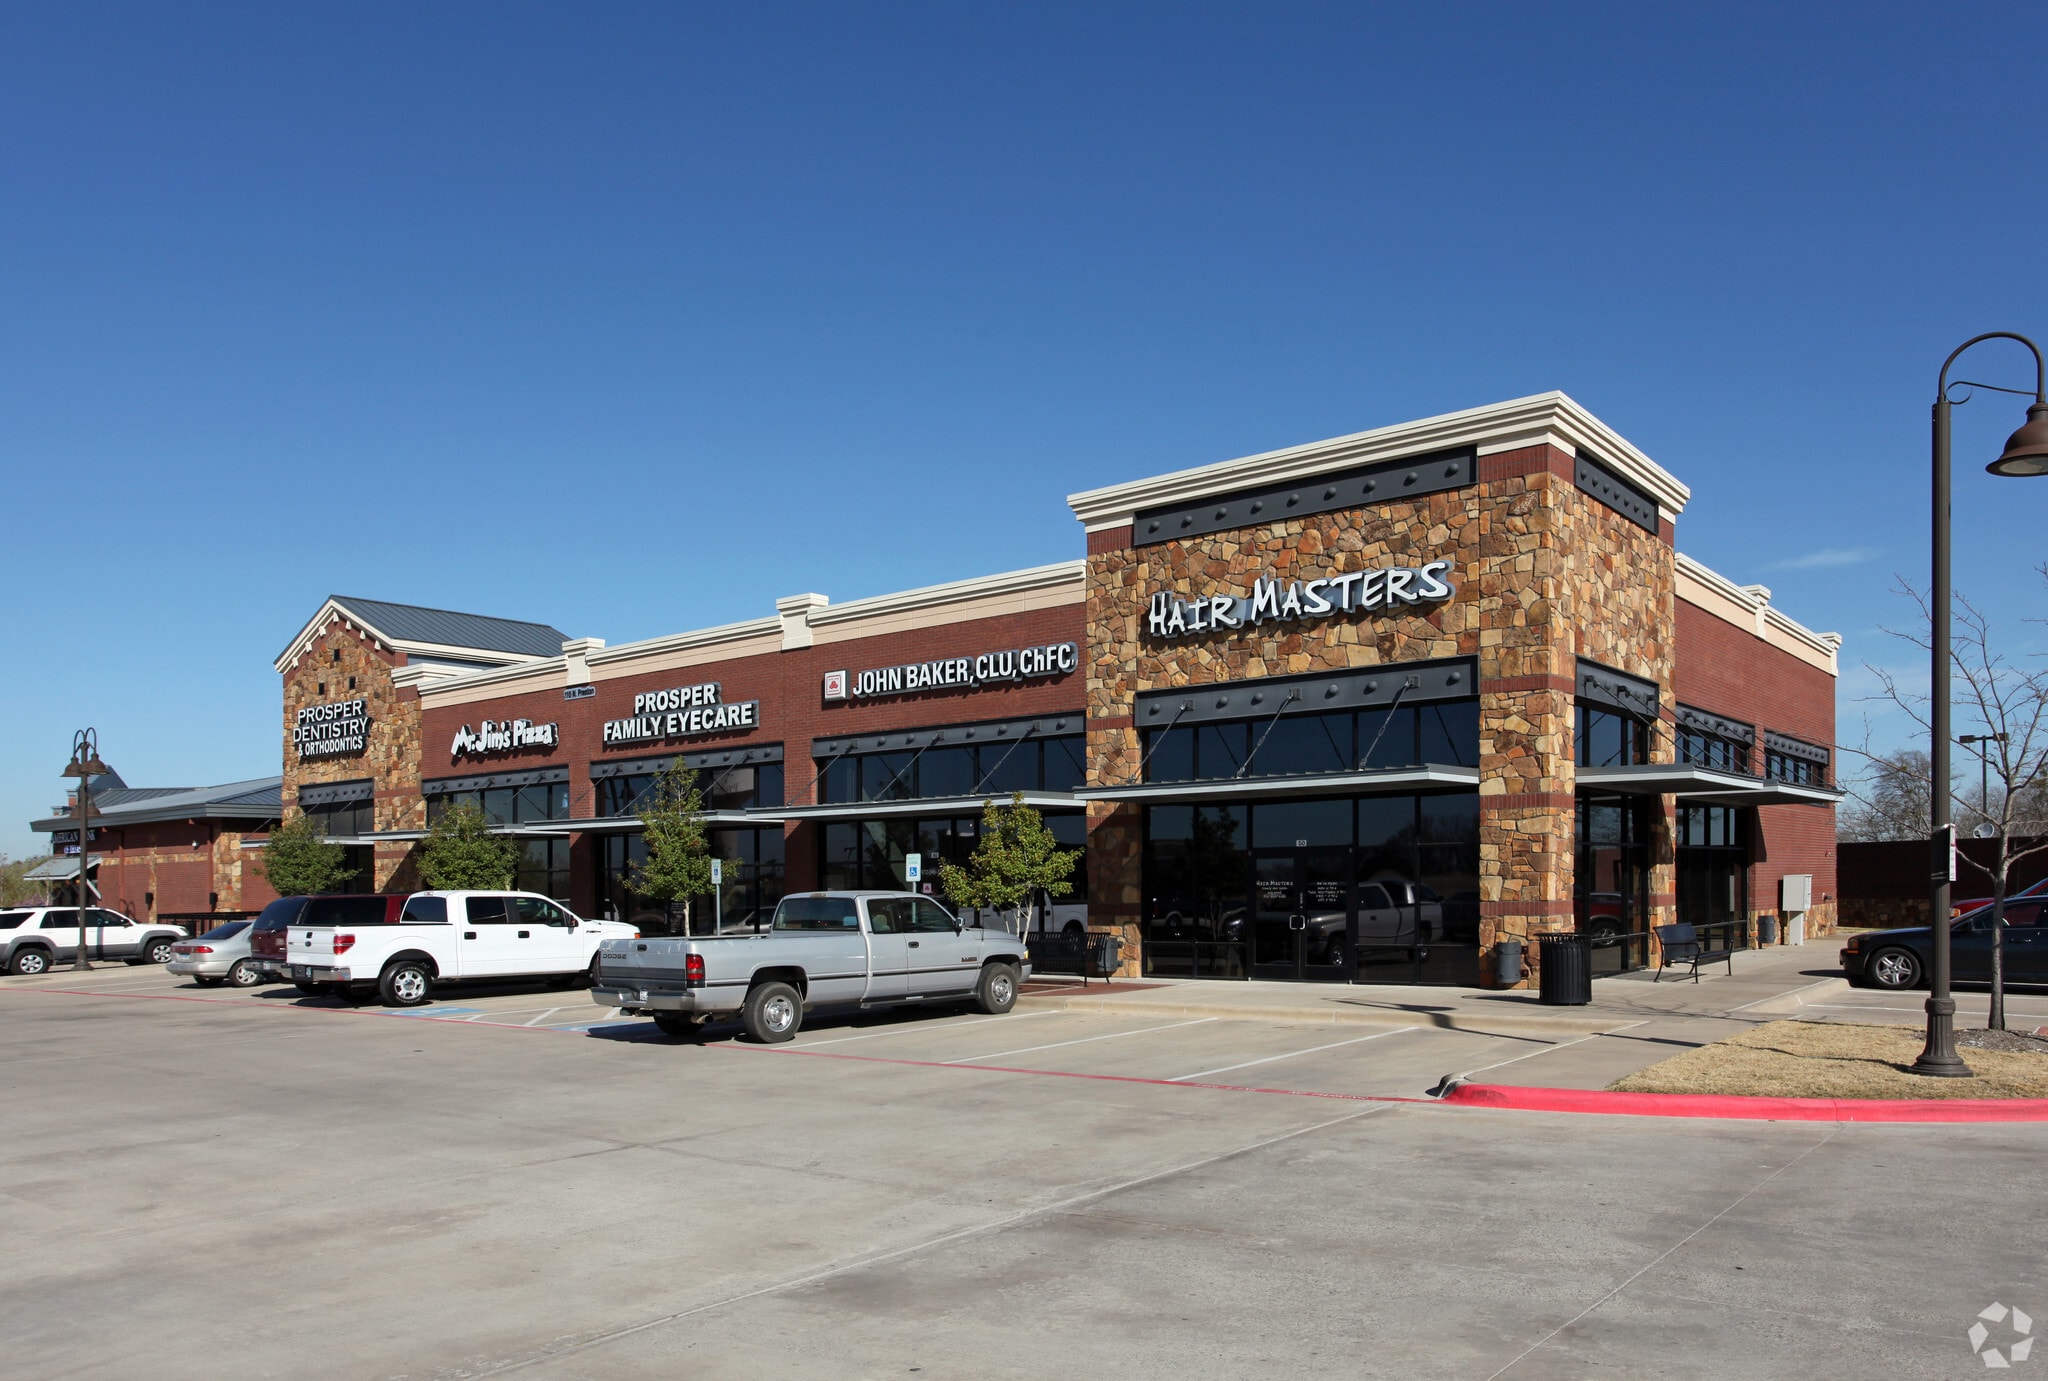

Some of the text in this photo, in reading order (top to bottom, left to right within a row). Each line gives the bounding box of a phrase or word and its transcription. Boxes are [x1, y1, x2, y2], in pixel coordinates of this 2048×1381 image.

[1149, 562, 1449, 635] HAIR MASTERS
[852, 667, 901, 695] JOHN
[906, 659, 974, 689] BAKER,
[975, 651, 1017, 679] CLU,
[297, 700, 363, 725] PROSPER
[635, 683, 716, 714] PROSPER
[293, 716, 369, 742] DENTISTRY
[451, 720, 553, 755] Mr. Jim's Pizza
[603, 703, 753, 742] FAMILY EYECARE
[298, 735, 363, 756] & ORTHODONTICS
